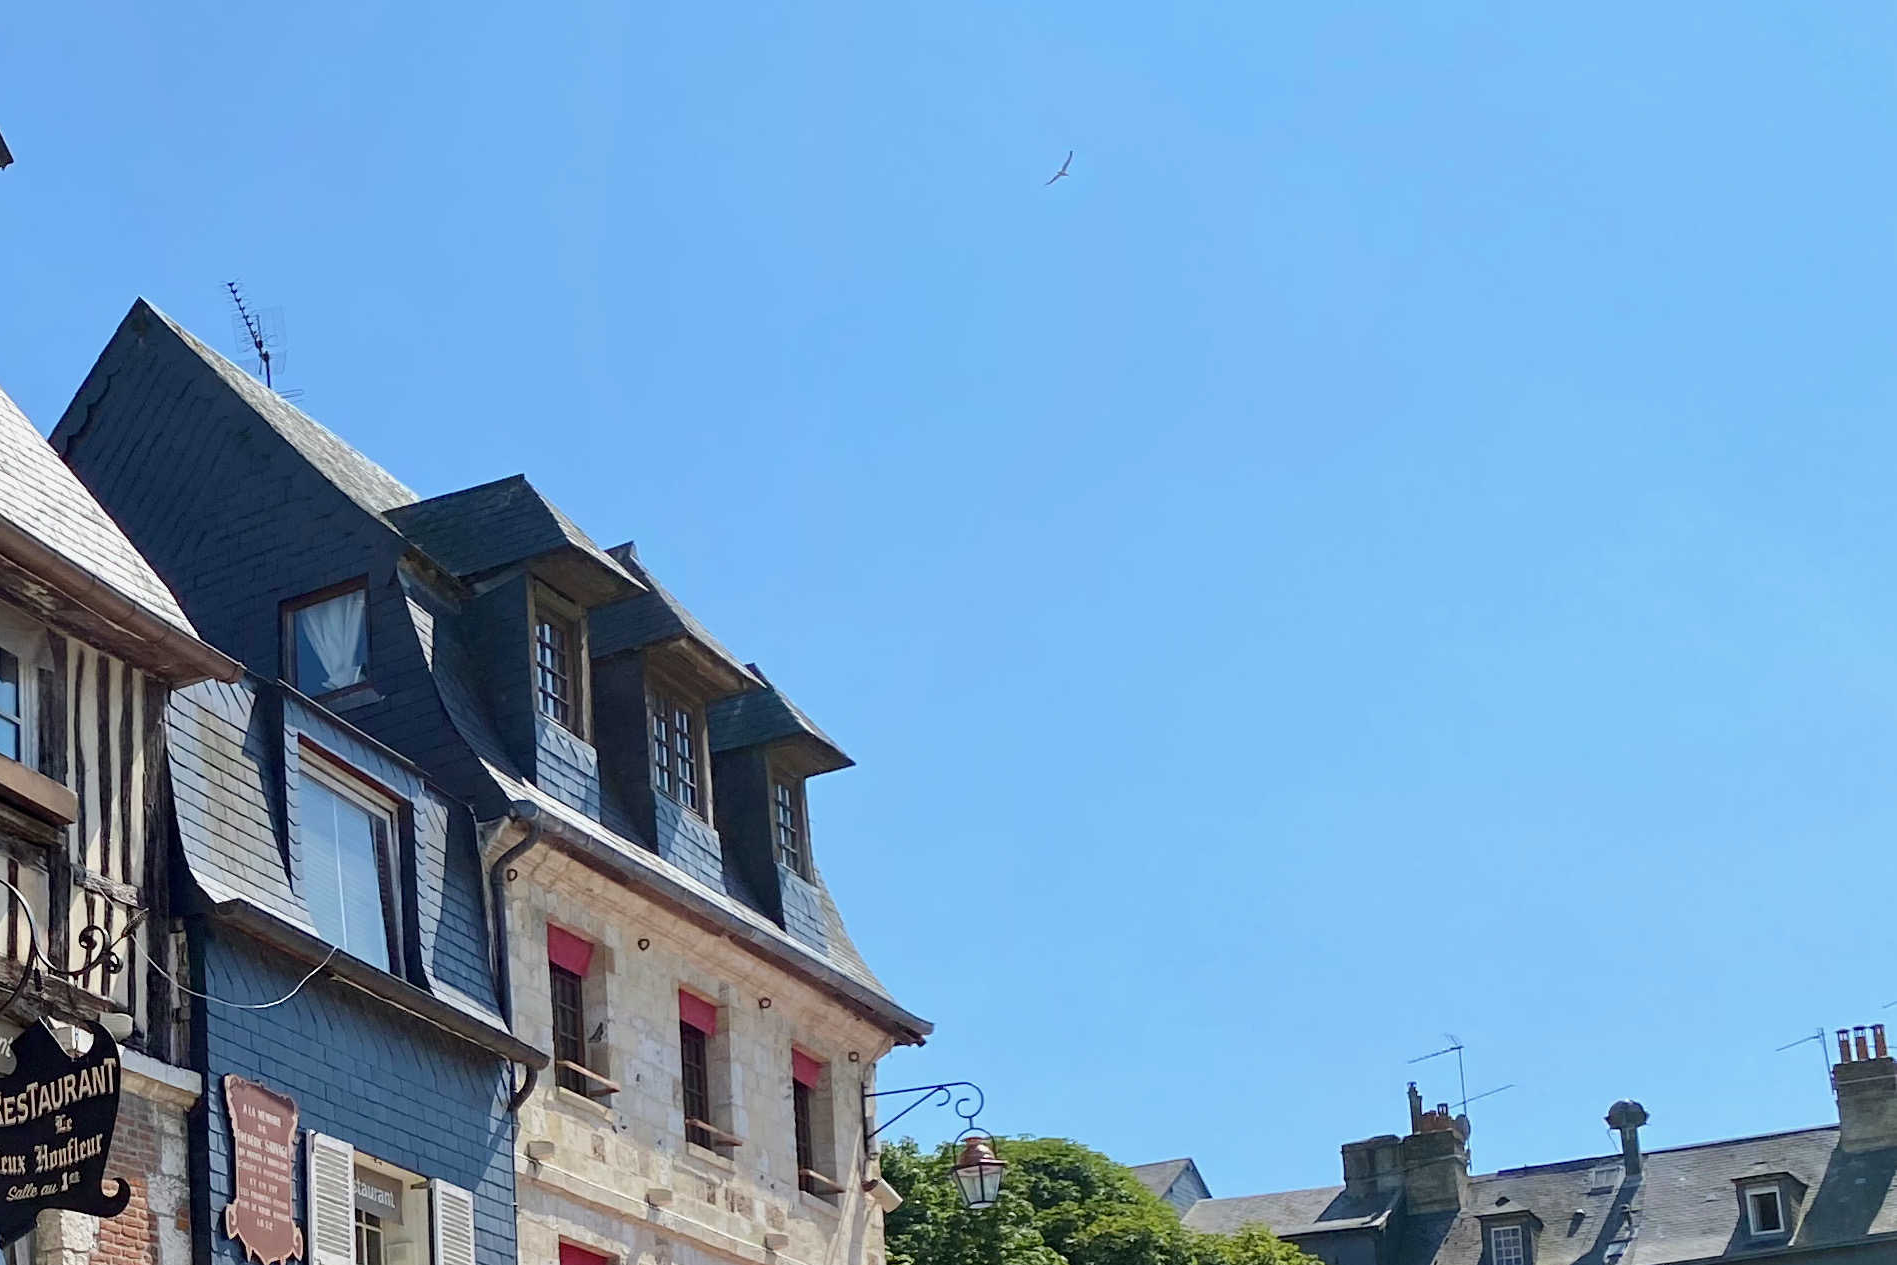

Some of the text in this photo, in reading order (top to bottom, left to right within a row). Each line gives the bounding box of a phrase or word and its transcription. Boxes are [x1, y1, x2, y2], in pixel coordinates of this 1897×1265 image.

[55, 1114, 73, 1135] Le
[34, 1133, 103, 1174] Honfleur
[6, 1182, 39, 1202] Salle
[41, 1182, 59, 1197] au
